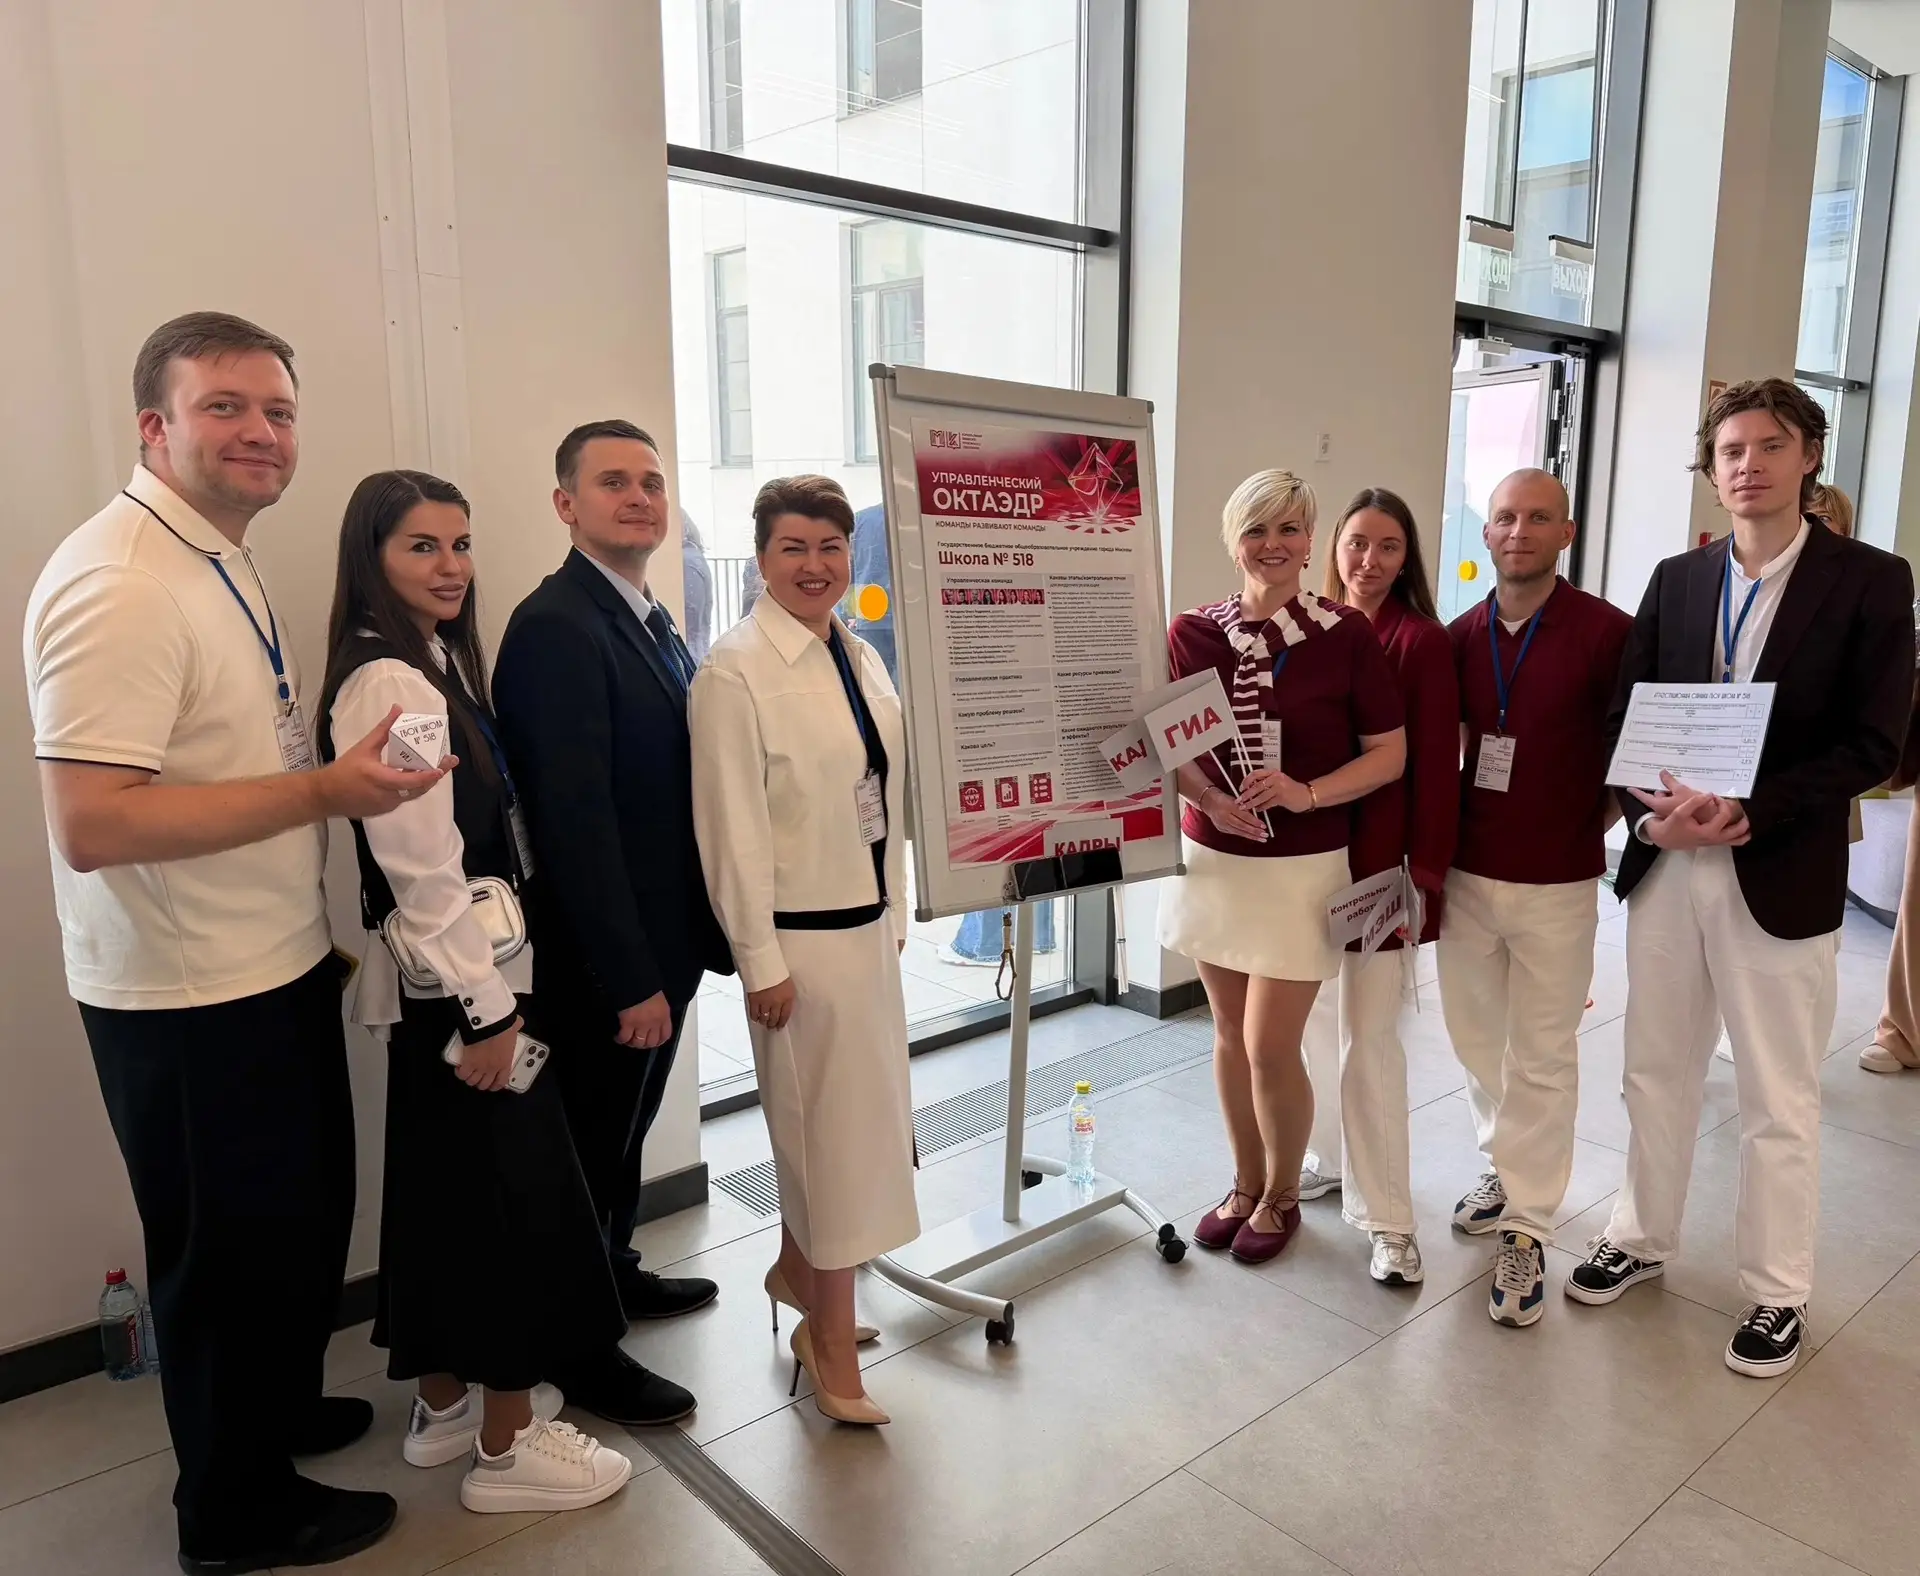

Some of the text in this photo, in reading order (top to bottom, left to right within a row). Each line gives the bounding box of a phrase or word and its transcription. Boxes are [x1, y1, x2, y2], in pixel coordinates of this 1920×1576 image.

[932, 471, 1041, 490] УПРАВЛЕНЧЕСКИЙ
[933, 488, 1044, 518] ОКТАЭДР
[935, 520, 1046, 532] КОМАНДЫ РАЗВИВАЮТ КОМАНДЫ
[937, 541, 983, 549] Государственное
[938, 551, 1034, 566] Школа № 518
[1072, 670, 1092, 678] ресурсы
[1002, 708, 1025, 716] решаем?
[1164, 706, 1222, 749] ГИА
[423, 732, 437, 742] 518
[1346, 902, 1377, 922] работ
[1364, 894, 1402, 952] МЭШ
